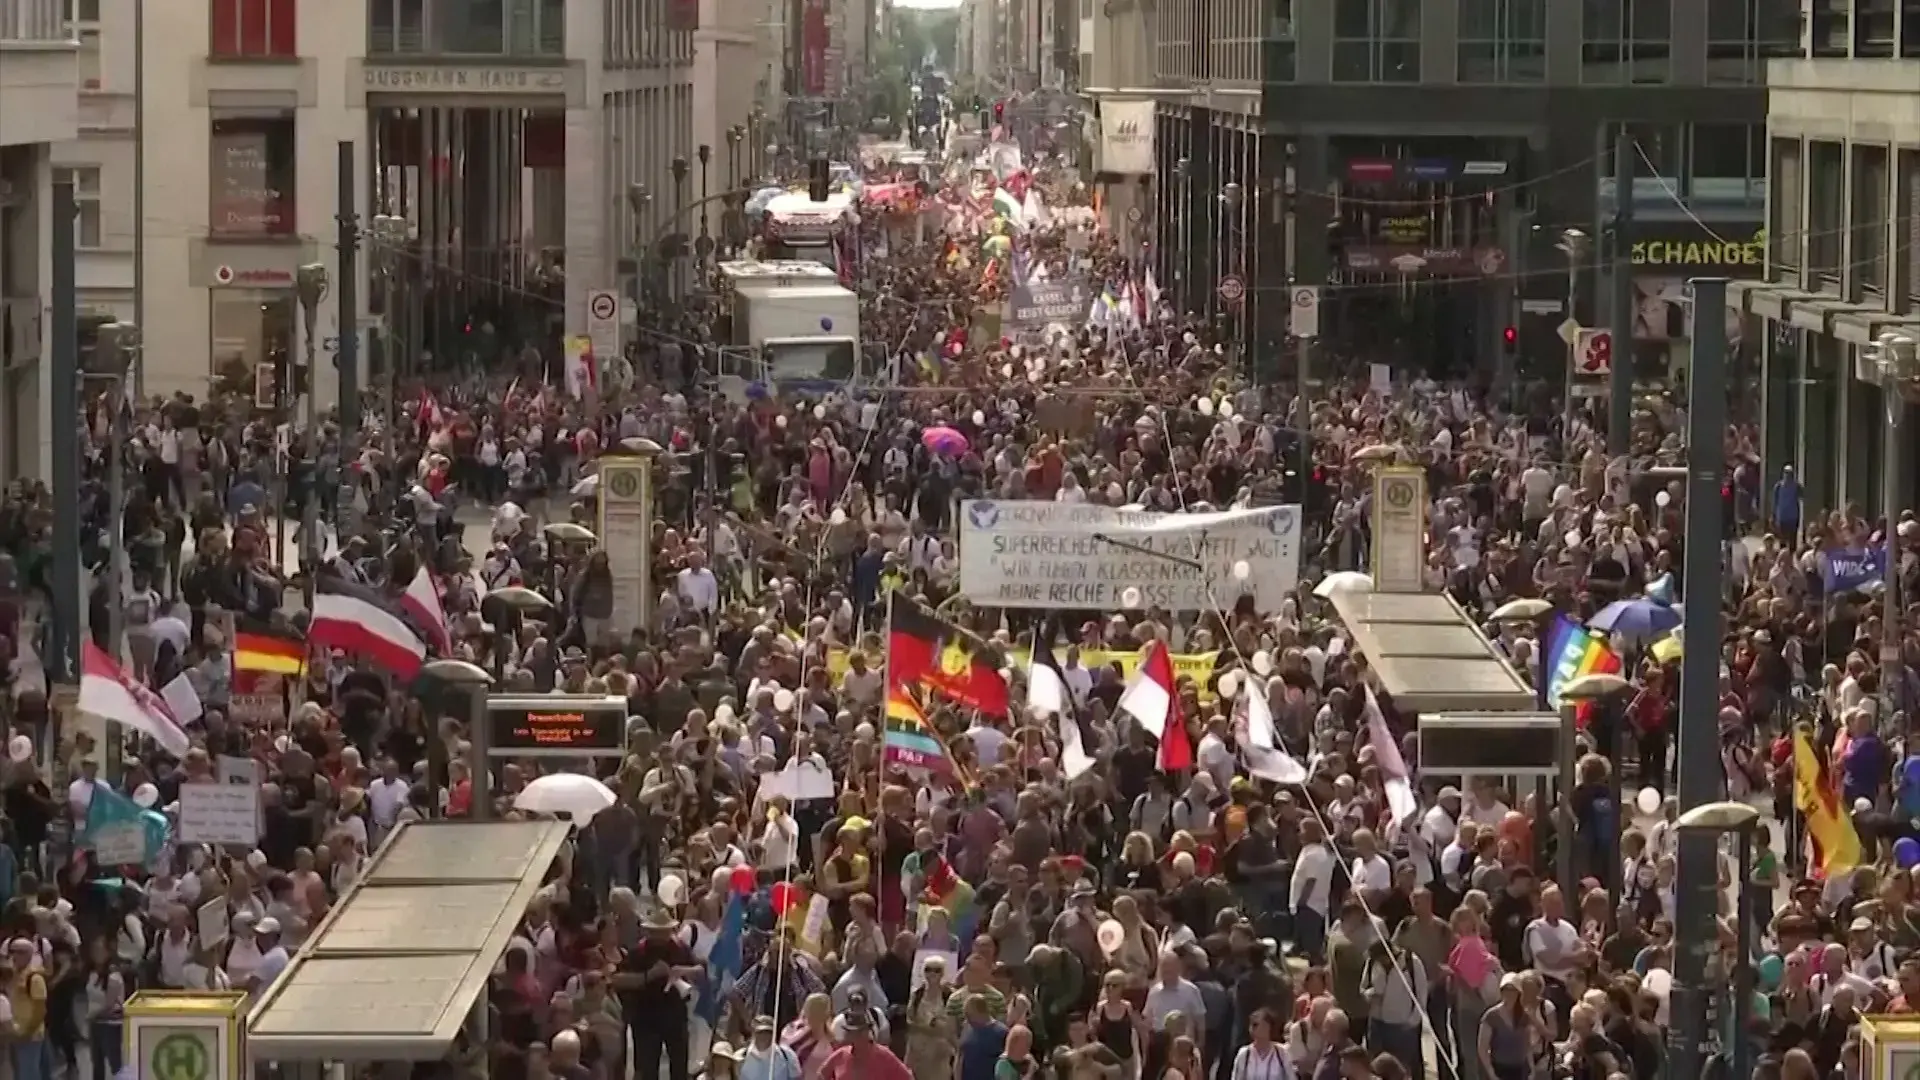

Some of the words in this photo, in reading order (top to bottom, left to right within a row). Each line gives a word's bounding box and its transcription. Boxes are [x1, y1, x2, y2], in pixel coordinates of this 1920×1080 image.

[365, 70, 468, 86] DUSSMANN
[1049, 582, 1105, 603] REICHE
[1112, 584, 1176, 604] KSSE
